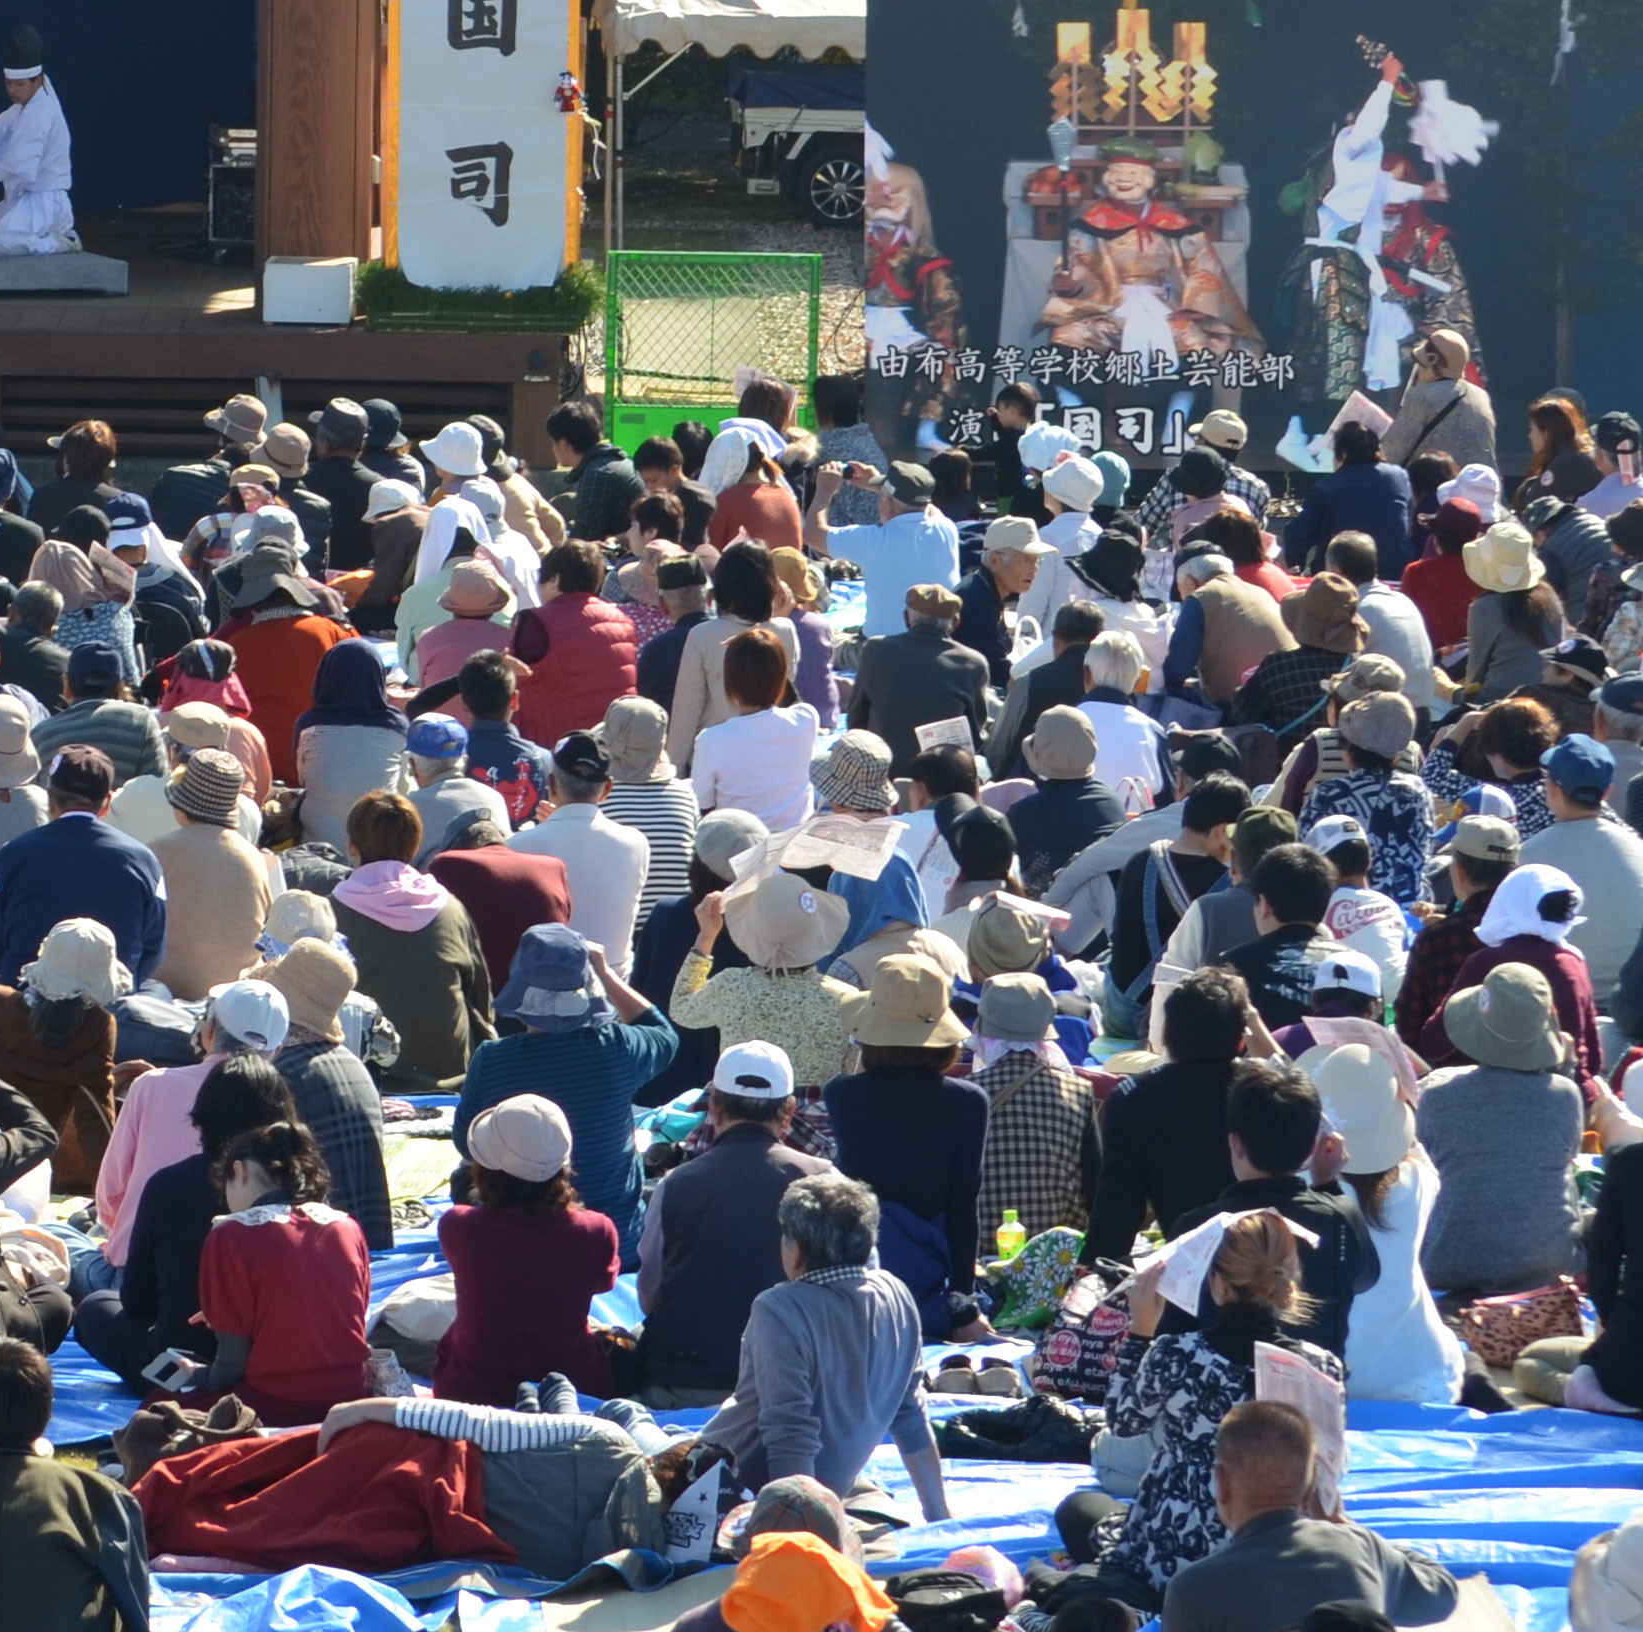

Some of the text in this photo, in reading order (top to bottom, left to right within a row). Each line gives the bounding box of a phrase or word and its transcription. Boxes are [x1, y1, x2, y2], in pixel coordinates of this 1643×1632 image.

[876, 344, 1296, 391] 由布高等学校郷土芸能部
